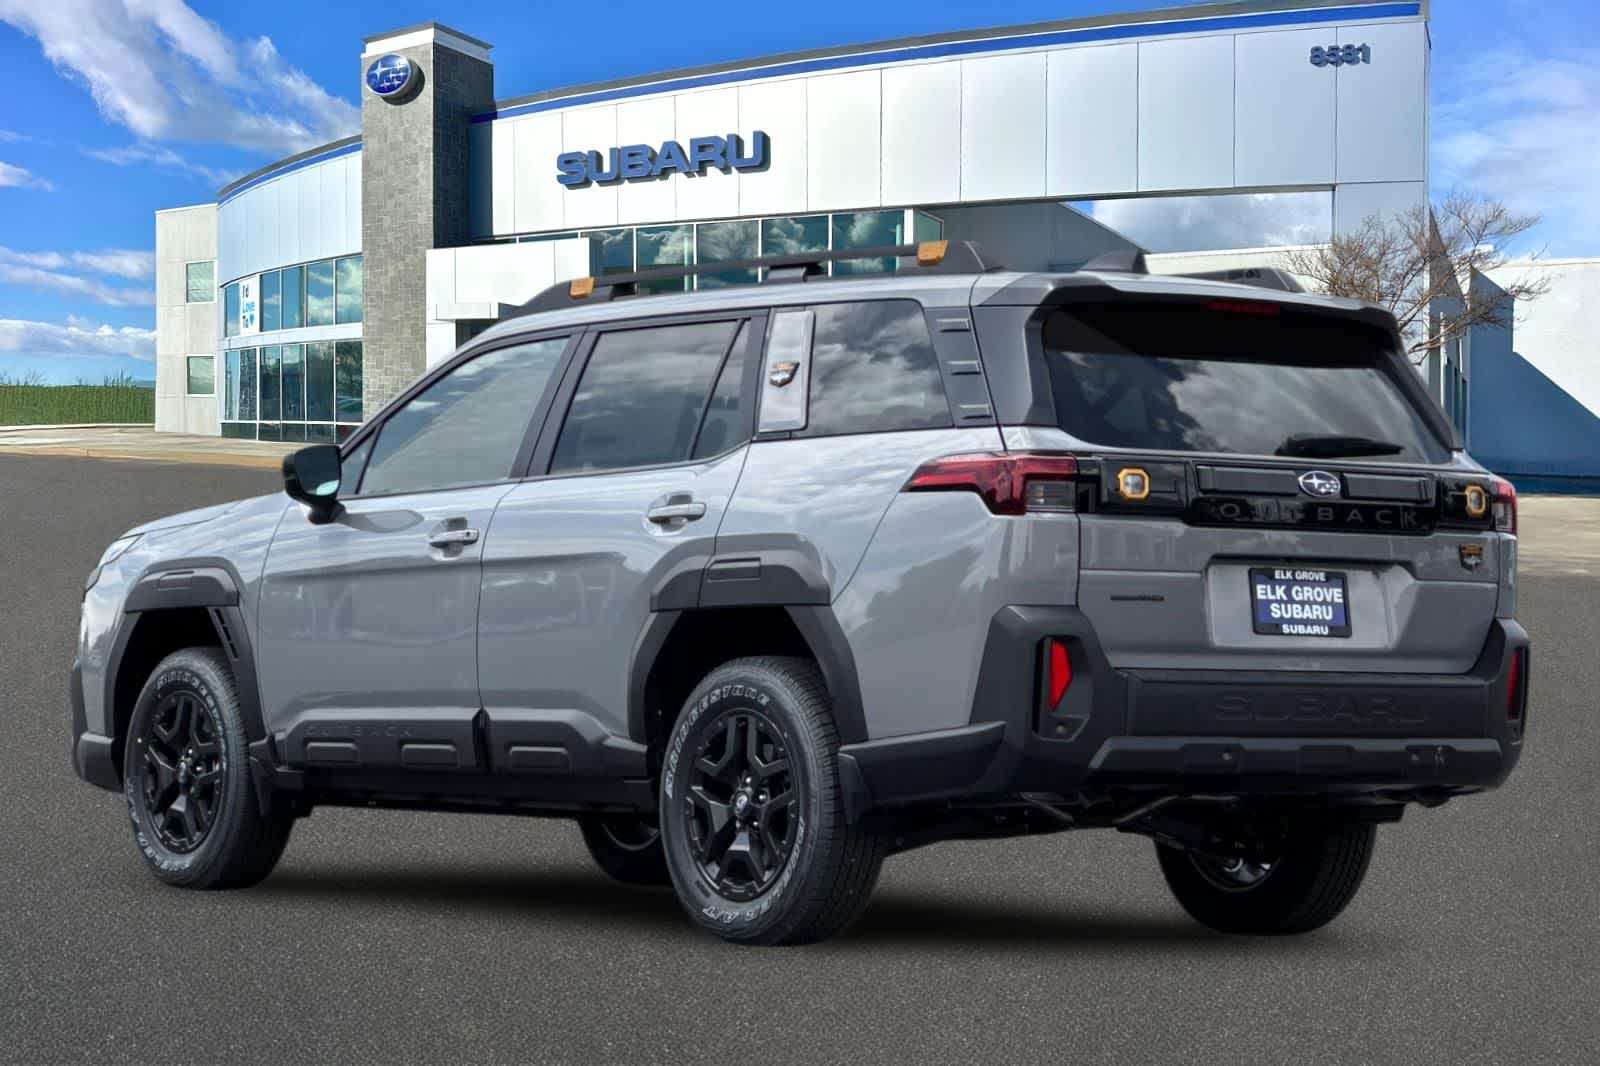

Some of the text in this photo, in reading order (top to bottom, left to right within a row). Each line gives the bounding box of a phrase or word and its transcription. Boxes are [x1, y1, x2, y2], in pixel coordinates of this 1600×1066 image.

[557, 130, 770, 189] SUBARU
[1274, 570, 1326, 582] ELK GROVE
[1256, 584, 1343, 603] ELK GROVE
[1270, 603, 1333, 621] SUBARU
[1282, 624, 1329, 635] SUBARU
